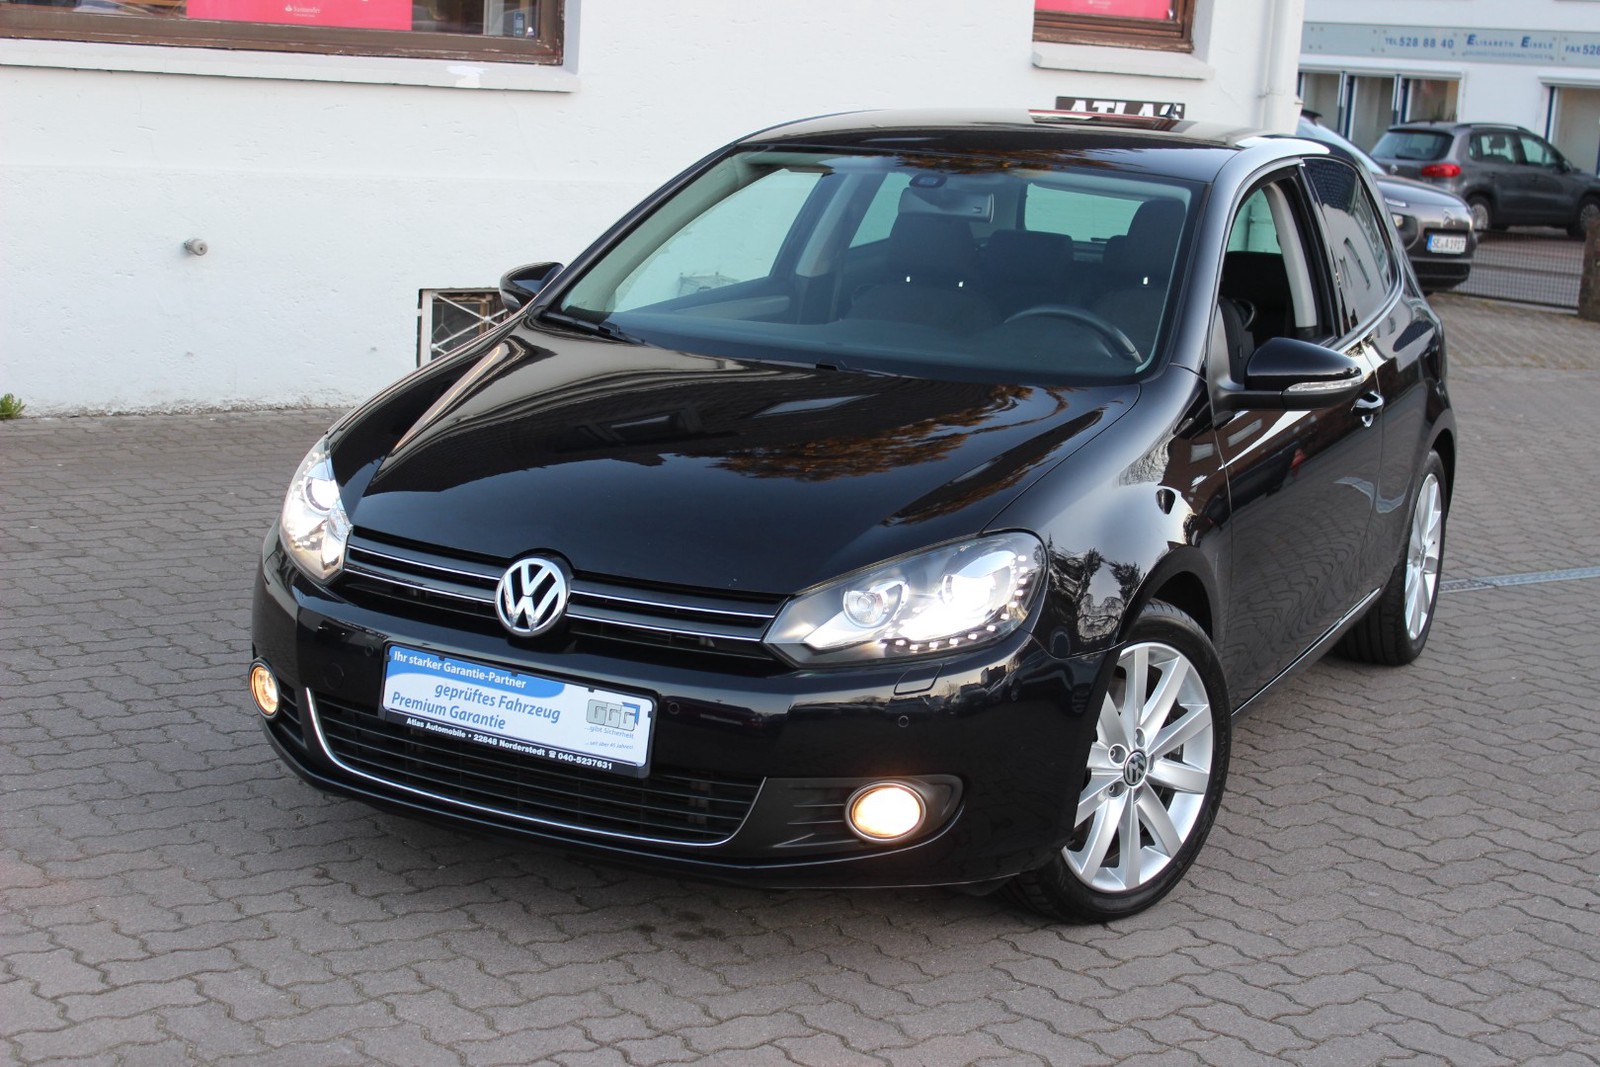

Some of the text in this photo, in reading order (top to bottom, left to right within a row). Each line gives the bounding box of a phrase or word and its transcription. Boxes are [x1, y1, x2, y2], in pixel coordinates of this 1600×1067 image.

[1398, 37, 1419, 48] 528
[394, 651, 527, 689] Ihr starker Garantie-Partner
[391, 692, 506, 729] Premium Garantie
[435, 684, 561, 724] geprüftes Fahrzeug
[406, 717, 613, 770] Atlas Automobile 22848 Norderstedt 040-5237631
